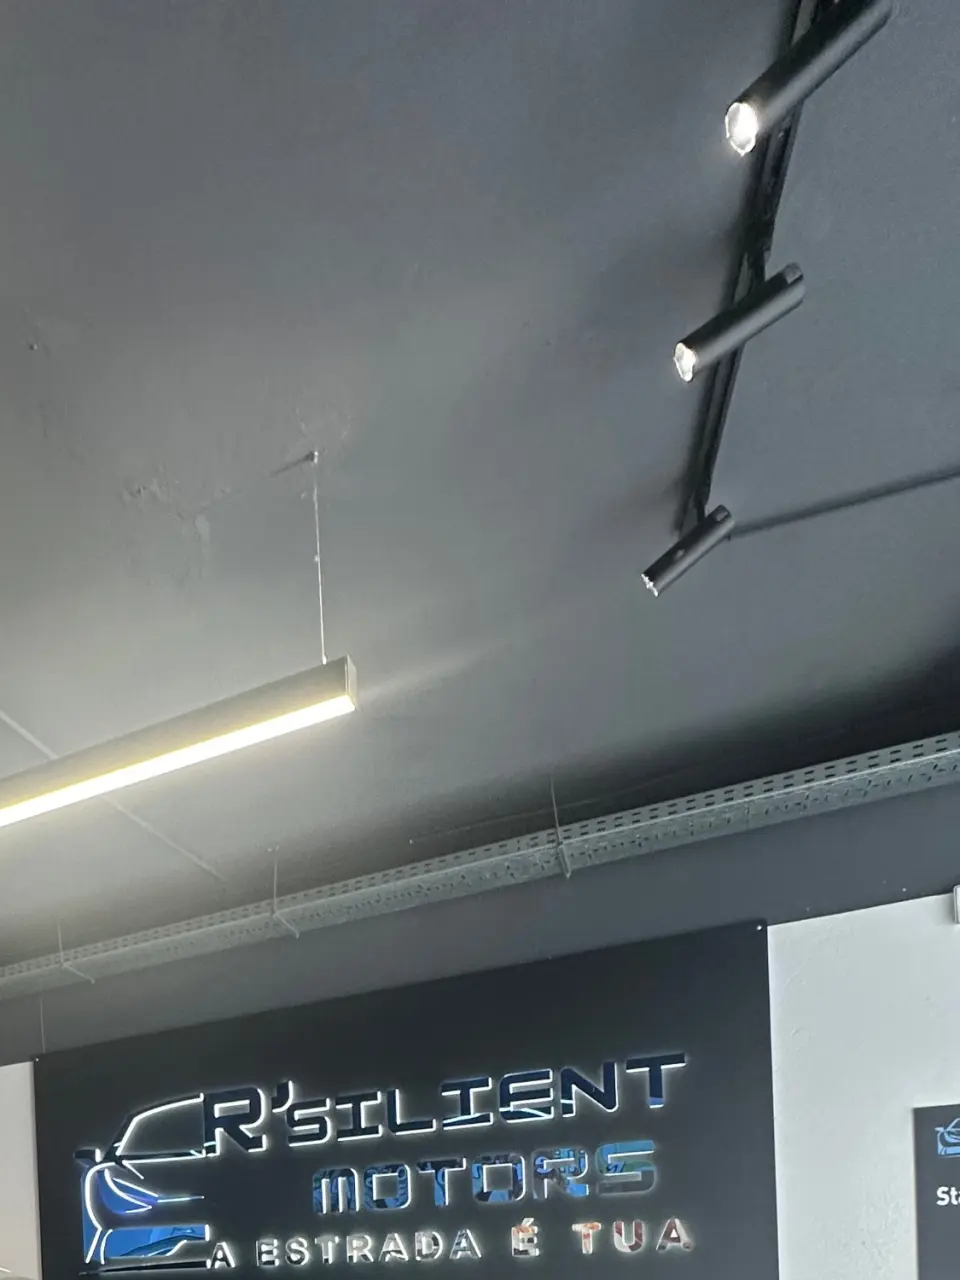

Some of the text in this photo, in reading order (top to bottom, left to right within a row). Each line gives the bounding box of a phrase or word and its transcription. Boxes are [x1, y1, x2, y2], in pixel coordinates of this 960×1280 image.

[312, 1139, 656, 1215] MOTORS
[209, 1217, 693, 1268] A ESTRADA É TUA
